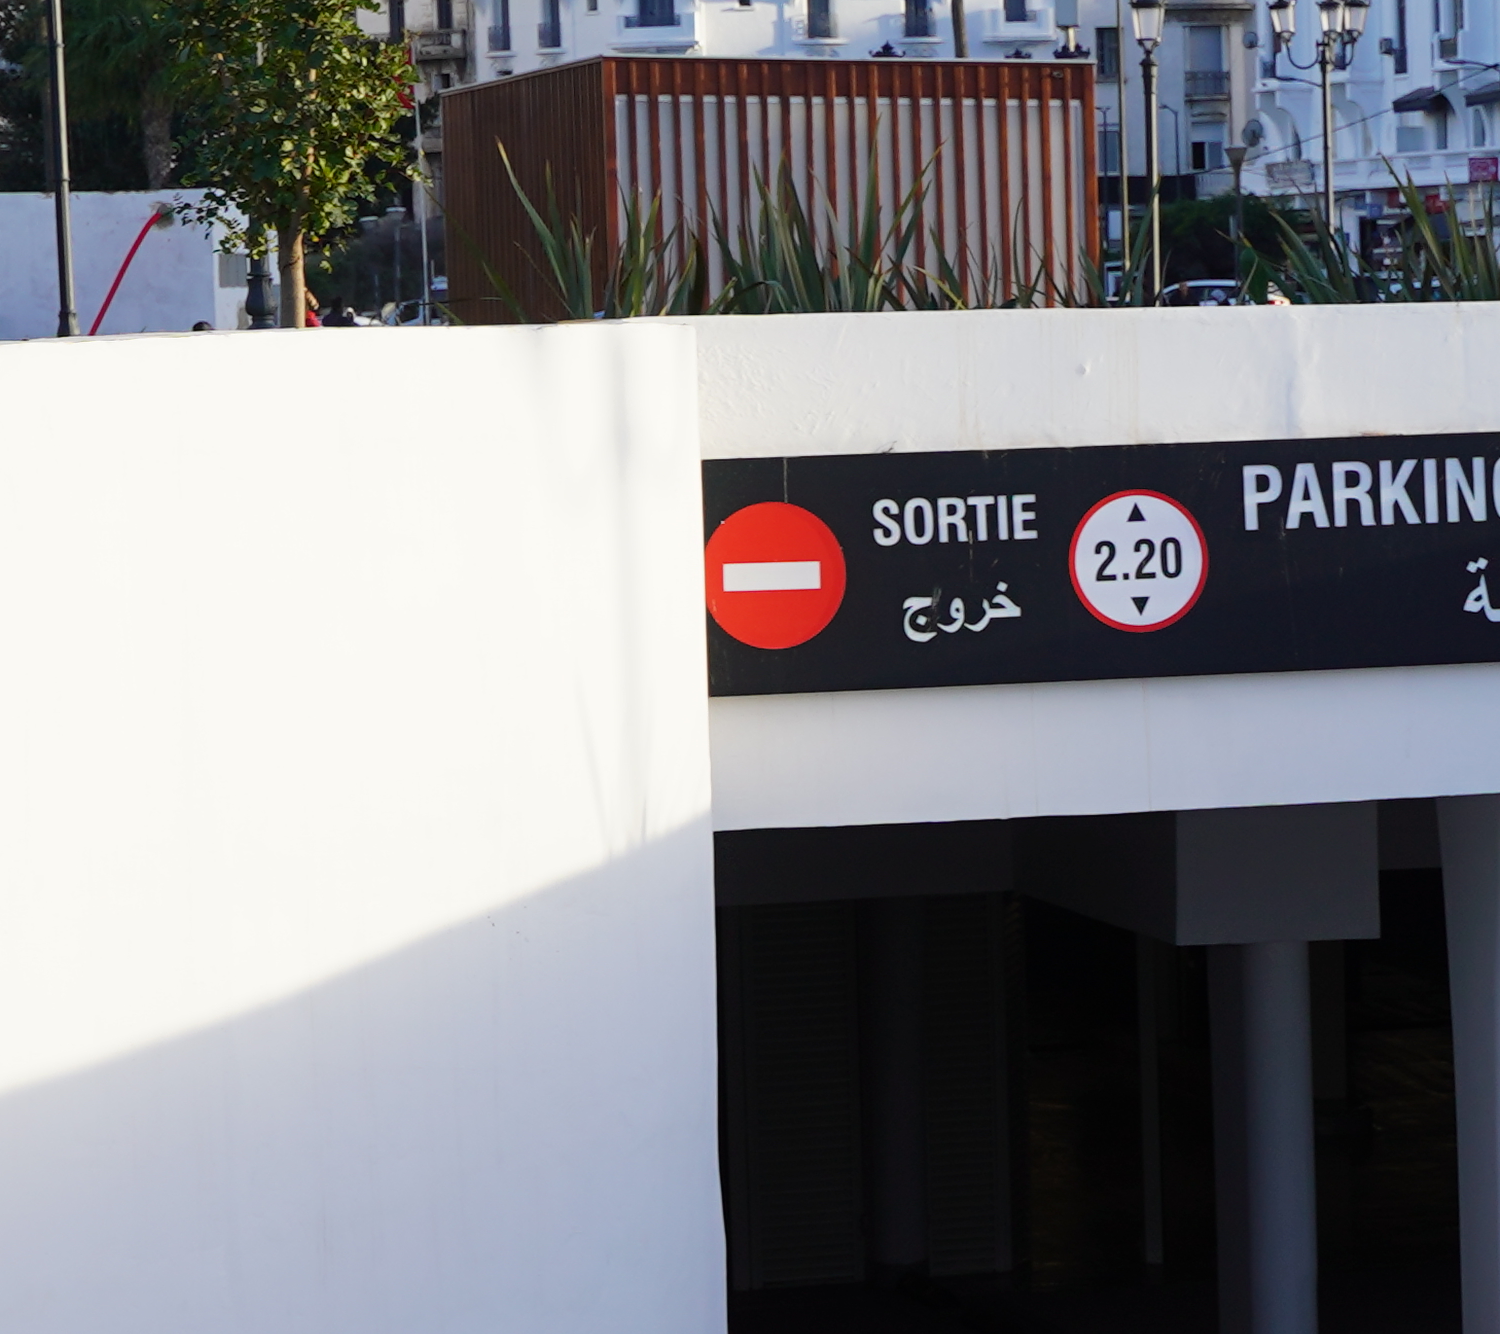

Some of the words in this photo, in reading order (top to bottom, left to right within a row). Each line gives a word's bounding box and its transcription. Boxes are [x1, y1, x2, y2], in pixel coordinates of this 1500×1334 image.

[873, 494, 1037, 546] SORTIE
[1095, 538, 1181, 581] 2.20
[903, 582, 1021, 642] خروج
